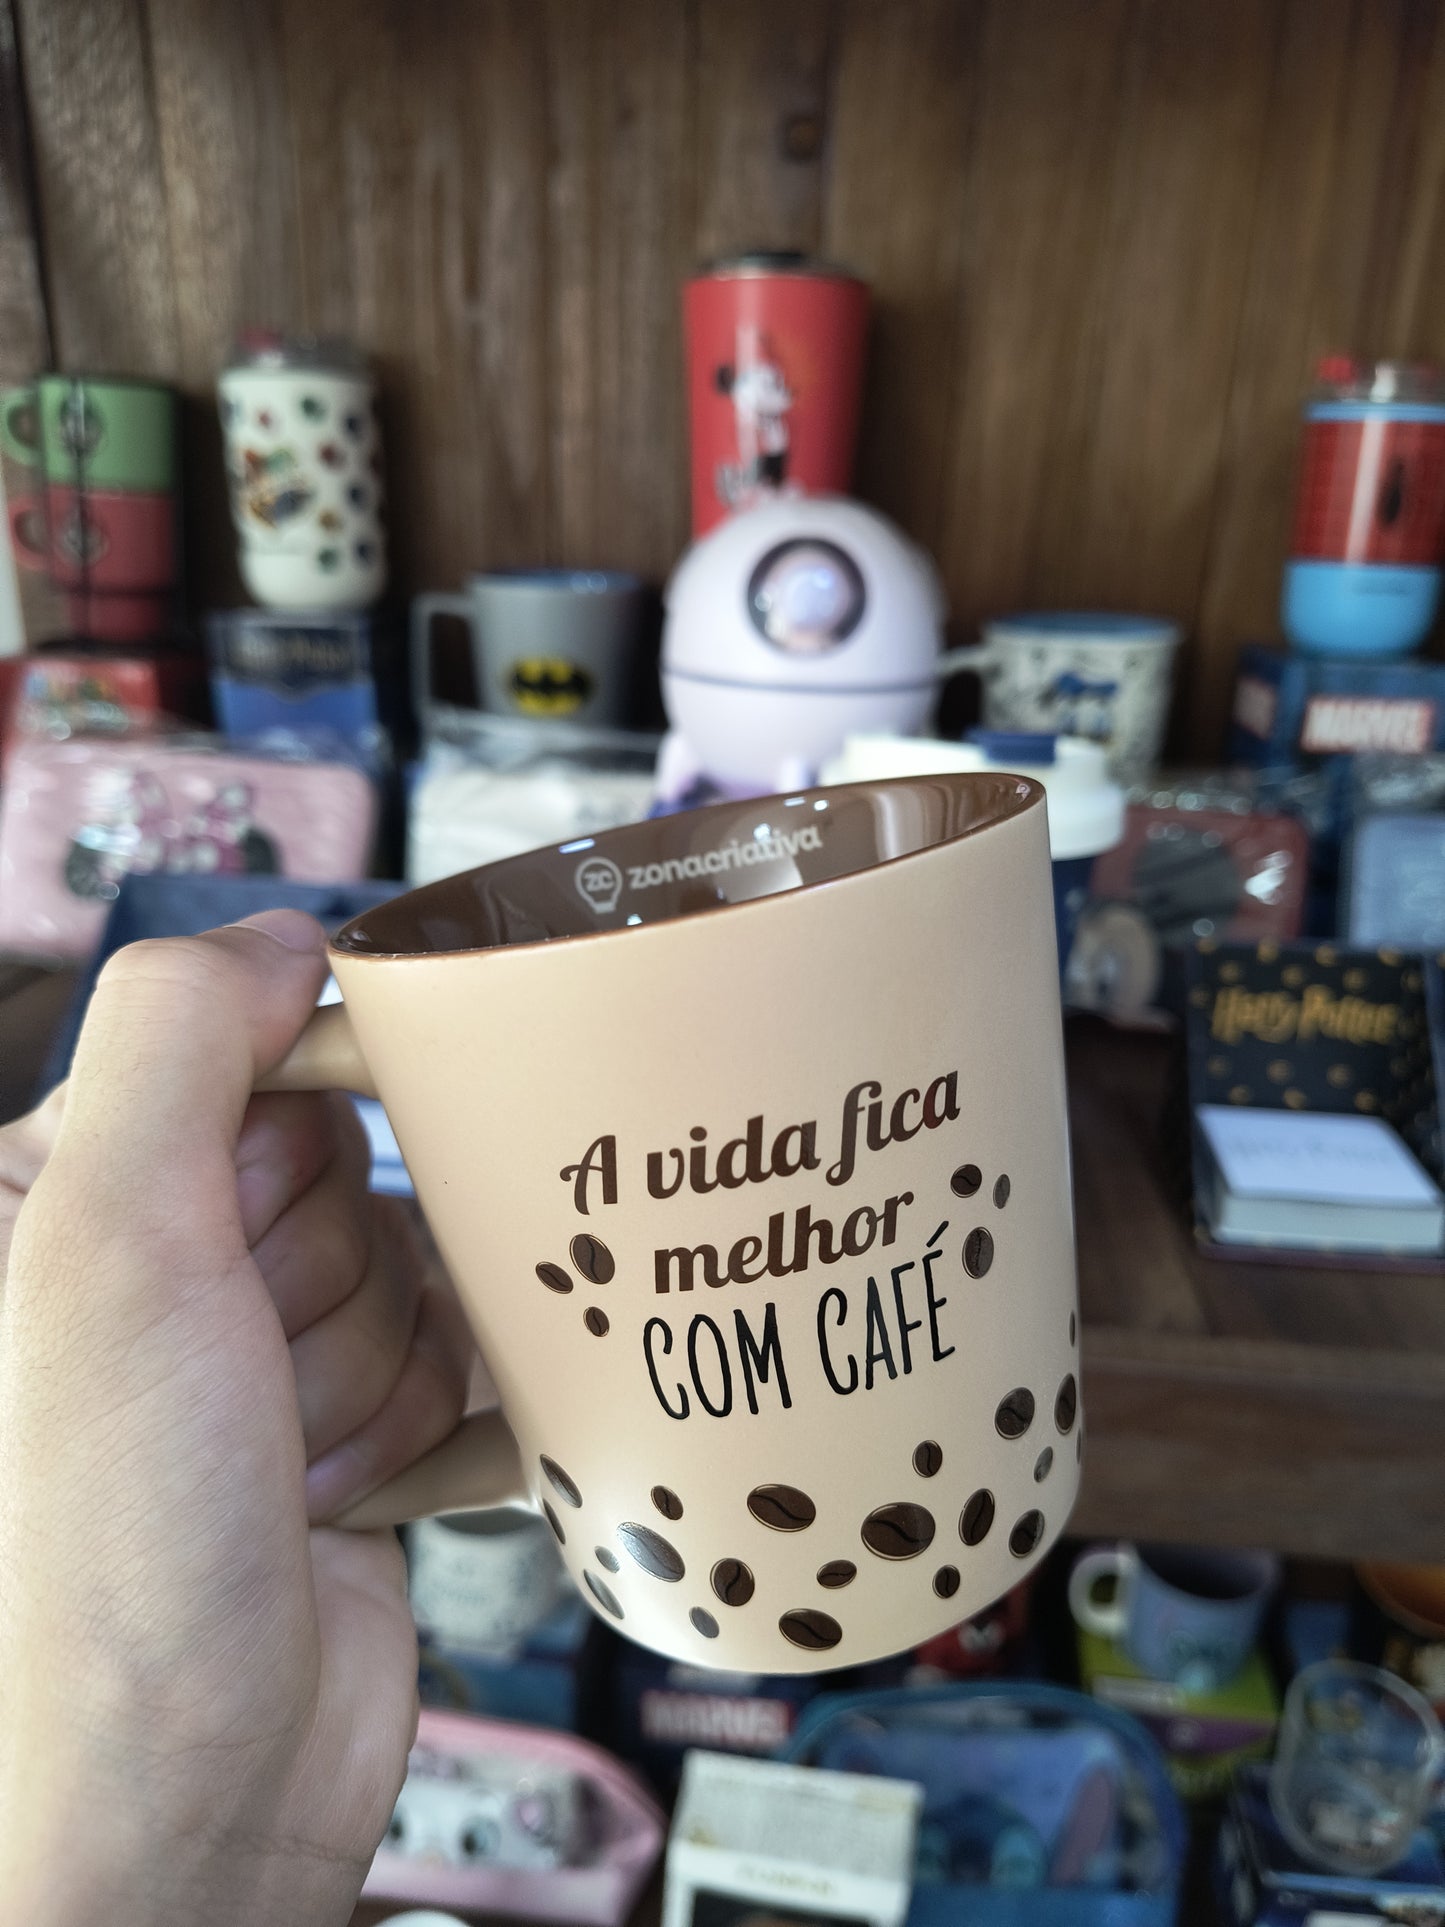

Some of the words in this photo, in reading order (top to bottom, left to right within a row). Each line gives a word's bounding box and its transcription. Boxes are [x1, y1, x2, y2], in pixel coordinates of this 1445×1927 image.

[626, 825, 822, 890] zonacriativa
[559, 1134, 619, 1216] A
[646, 1114, 822, 1200] vida
[825, 1070, 961, 1187] fica
[654, 1191, 915, 1295] melhor
[642, 1302, 793, 1420] COM
[816, 1220, 956, 1396] CAFÉ
